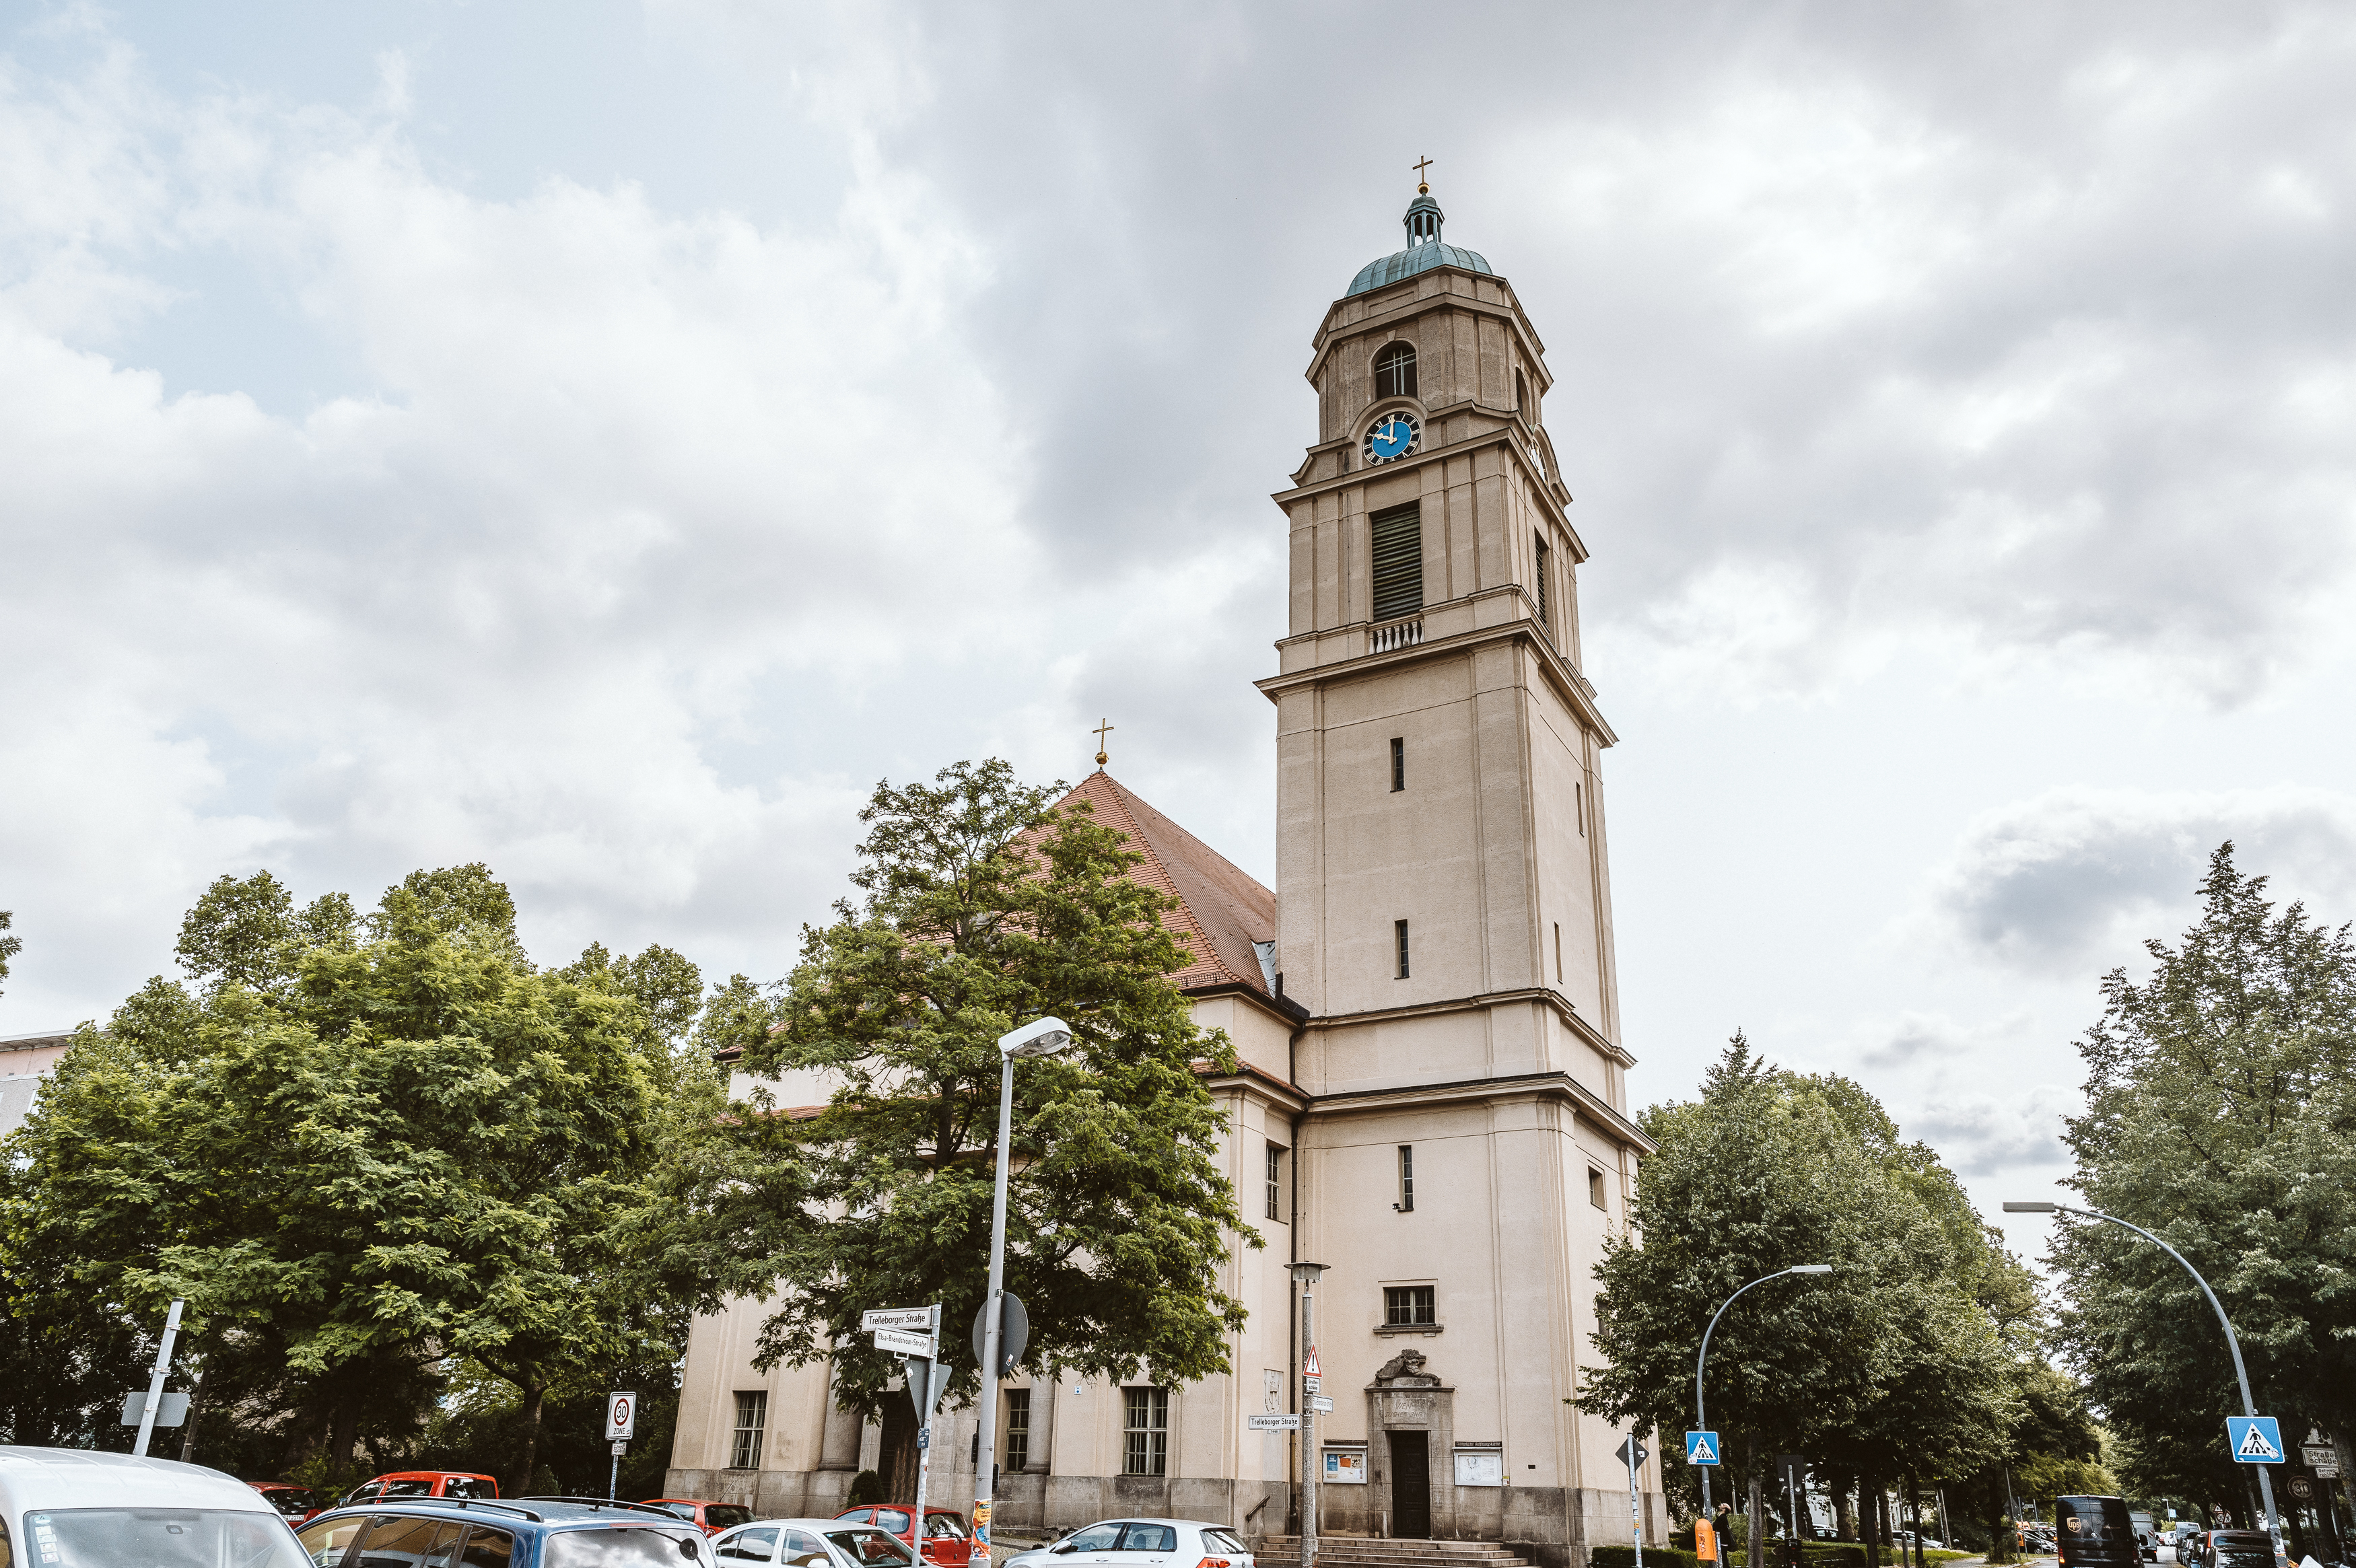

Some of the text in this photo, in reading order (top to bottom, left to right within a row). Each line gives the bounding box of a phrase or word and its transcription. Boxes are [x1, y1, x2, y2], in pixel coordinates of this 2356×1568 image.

[868, 1313, 926, 1325] Trelleborger Straße
[878, 1334, 927, 1349] Elsa-Brändström-Straße
[617, 1406, 626, 1418] 30
[1251, 1417, 1298, 1426] Trelleborger Straße
[2293, 1483, 2310, 1494] 30
[2069, 1521, 2081, 1530] ups
